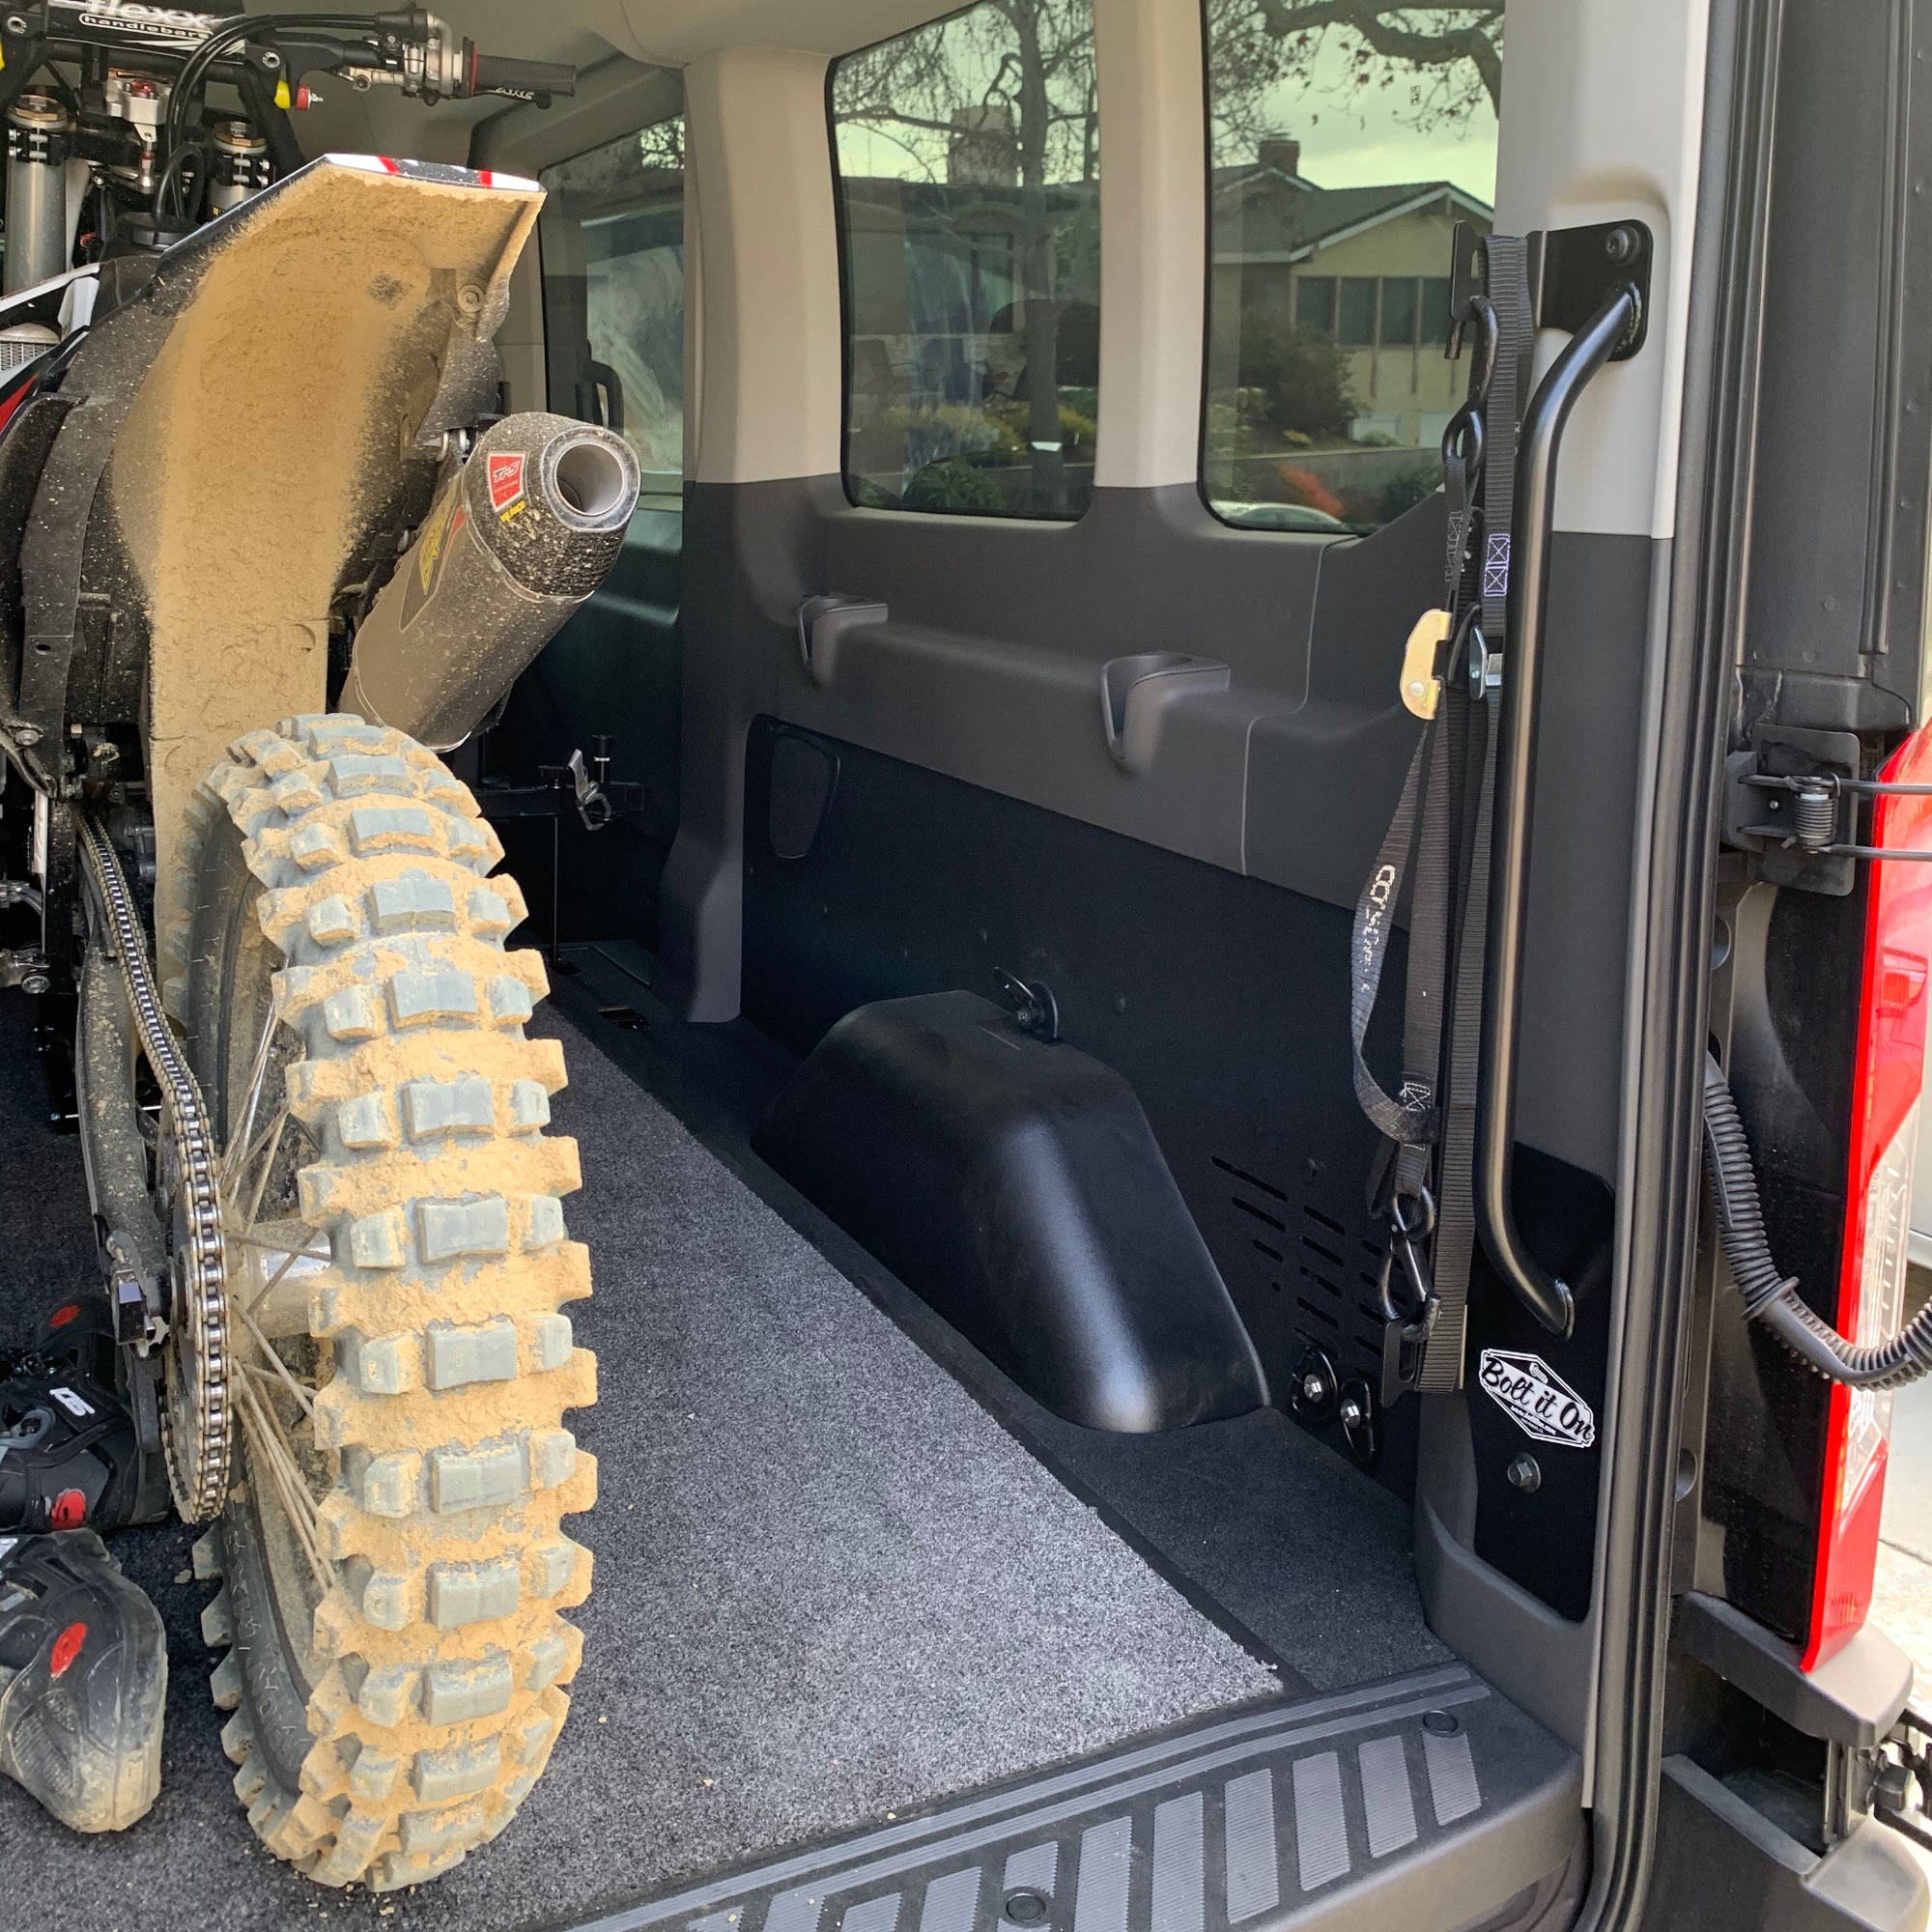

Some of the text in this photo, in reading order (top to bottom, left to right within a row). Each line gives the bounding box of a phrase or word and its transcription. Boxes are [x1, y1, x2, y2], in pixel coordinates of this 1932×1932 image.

[84, 15, 210, 39] handlebars
[1482, 1357, 1535, 1406] Bolt
[1534, 1390, 1558, 1419] it
[1559, 1402, 1593, 1440] On
